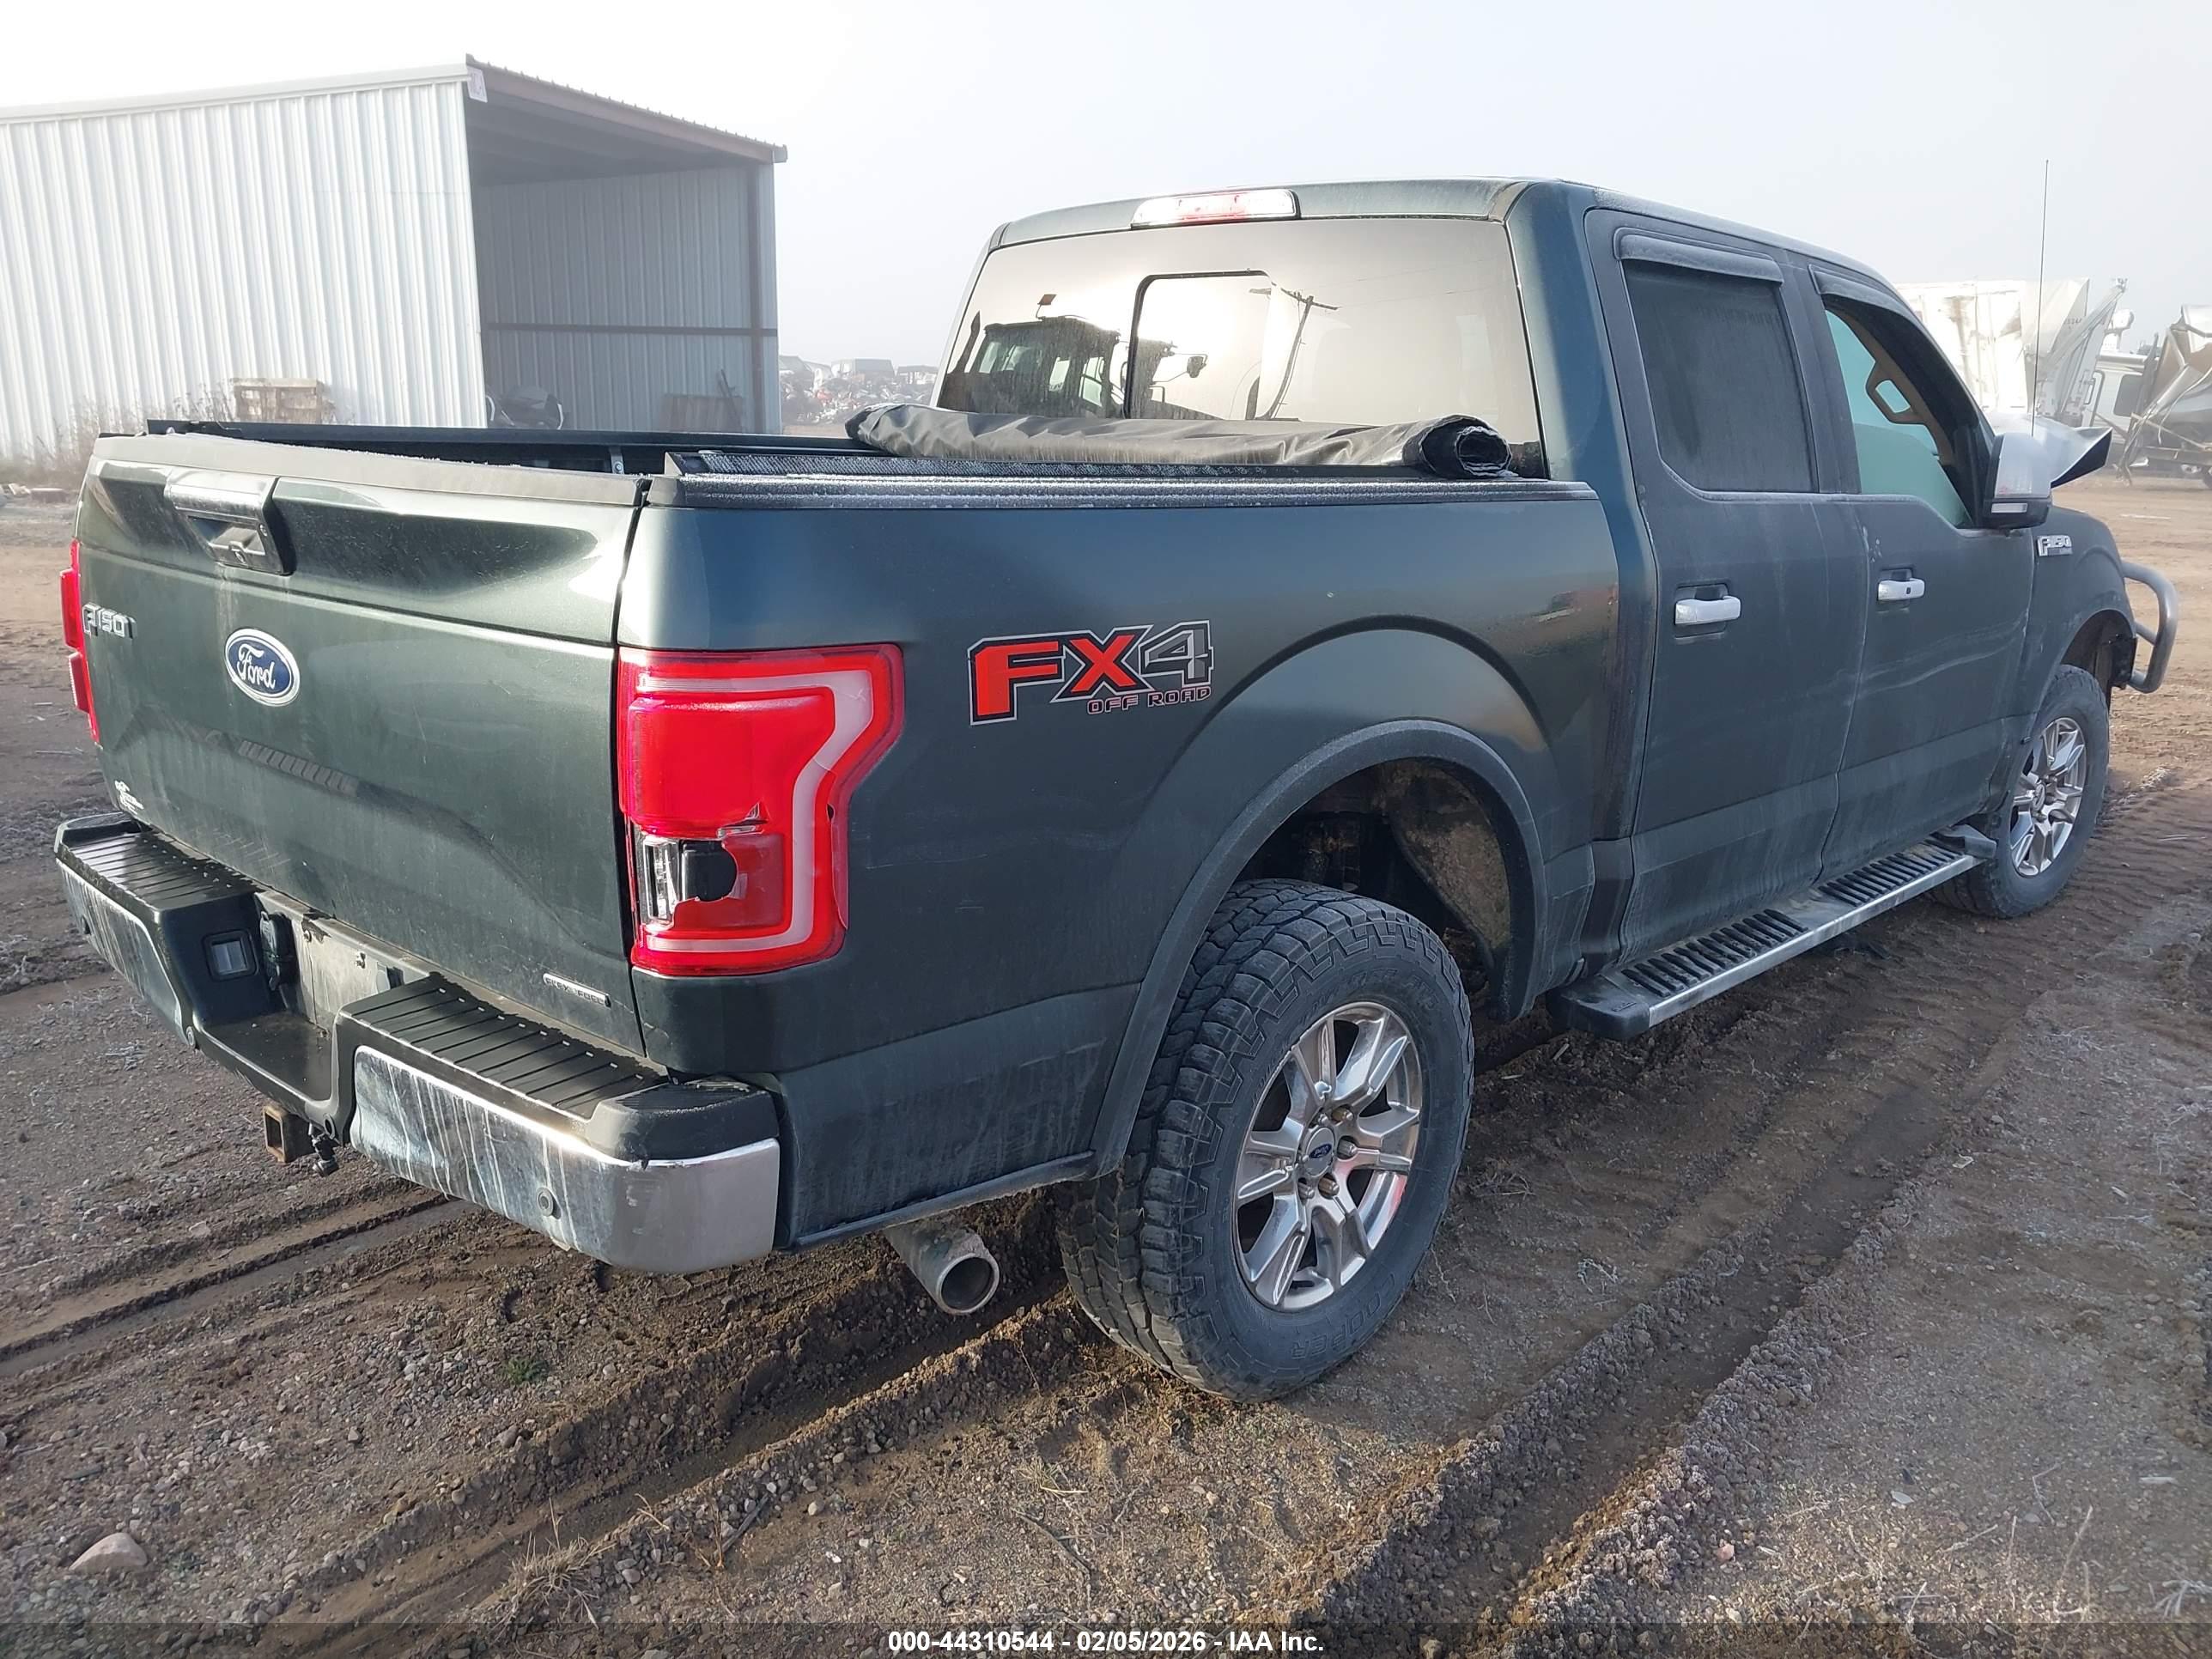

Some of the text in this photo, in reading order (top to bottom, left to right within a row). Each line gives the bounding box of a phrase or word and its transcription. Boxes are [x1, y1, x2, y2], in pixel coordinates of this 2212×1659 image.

[82, 602, 132, 639] F150
[236, 643, 276, 690] Ford
[968, 620, 1213, 725] FX4
[1086, 686, 1212, 714] OFF ROAD
[1291, 1273, 1395, 1359] COOPER
